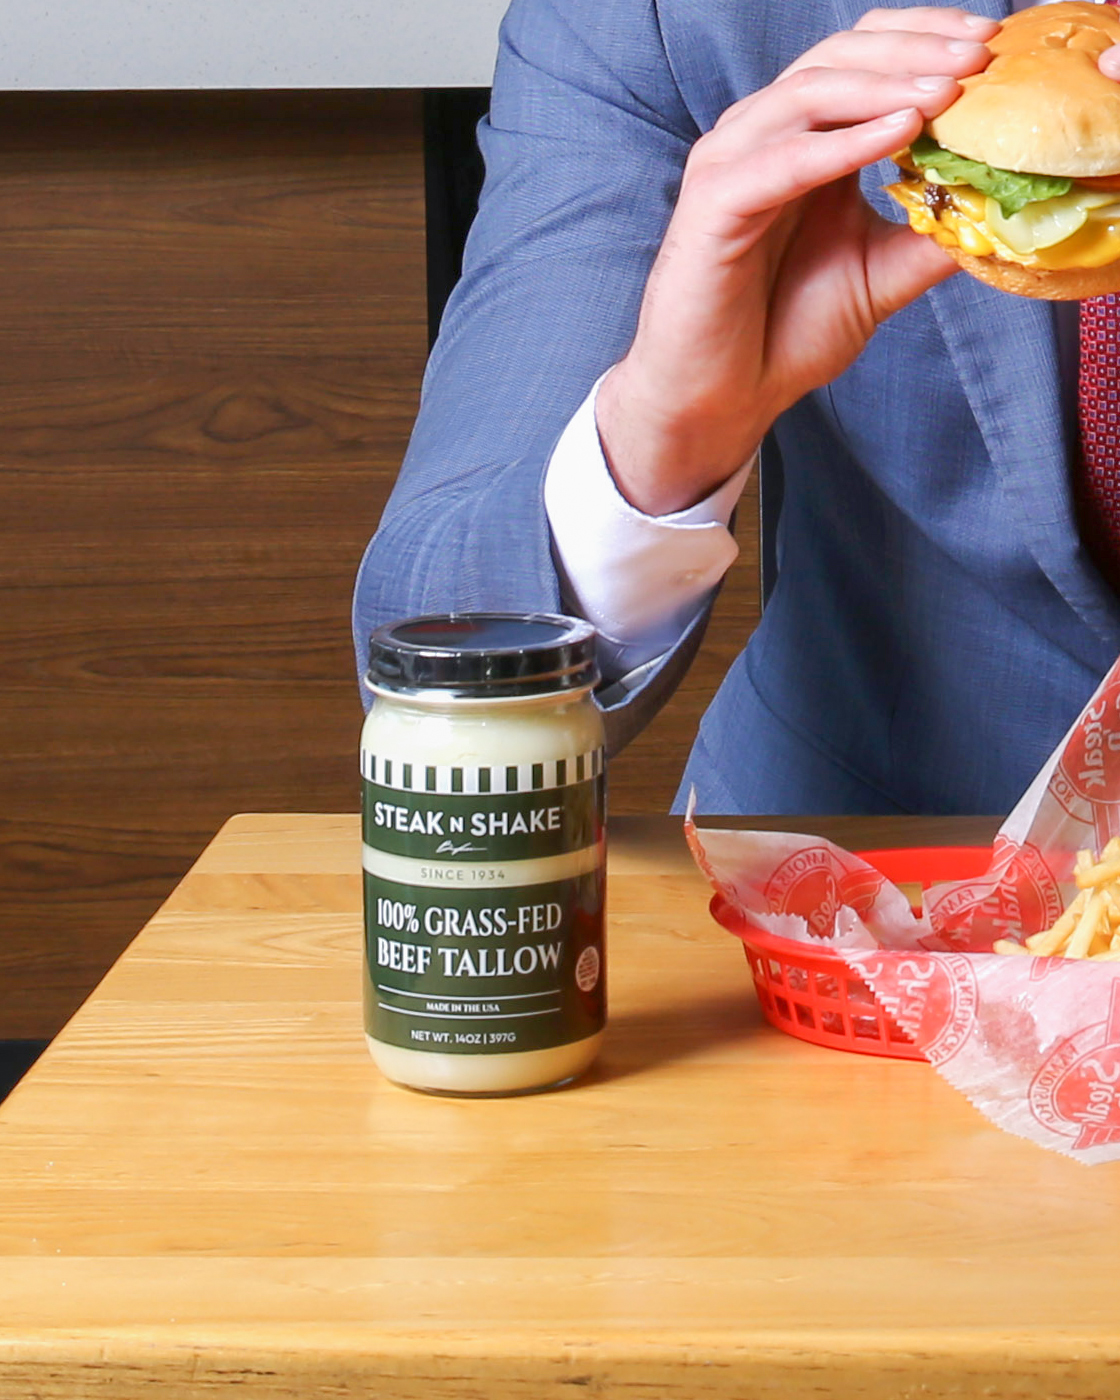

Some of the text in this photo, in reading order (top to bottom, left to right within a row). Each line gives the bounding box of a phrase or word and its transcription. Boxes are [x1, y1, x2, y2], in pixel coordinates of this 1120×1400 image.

[374, 801, 562, 837] STEAK N SHAKE
[421, 867, 505, 881] SINCE 1934
[377, 898, 562, 937] 100% GRASS-FED
[377, 936, 431, 974] BEEF
[438, 942, 562, 977] TALLOW
[426, 1002, 500, 1013] MADE IN THE USA
[411, 1029, 516, 1044] NET WT. 14OZ 397G
